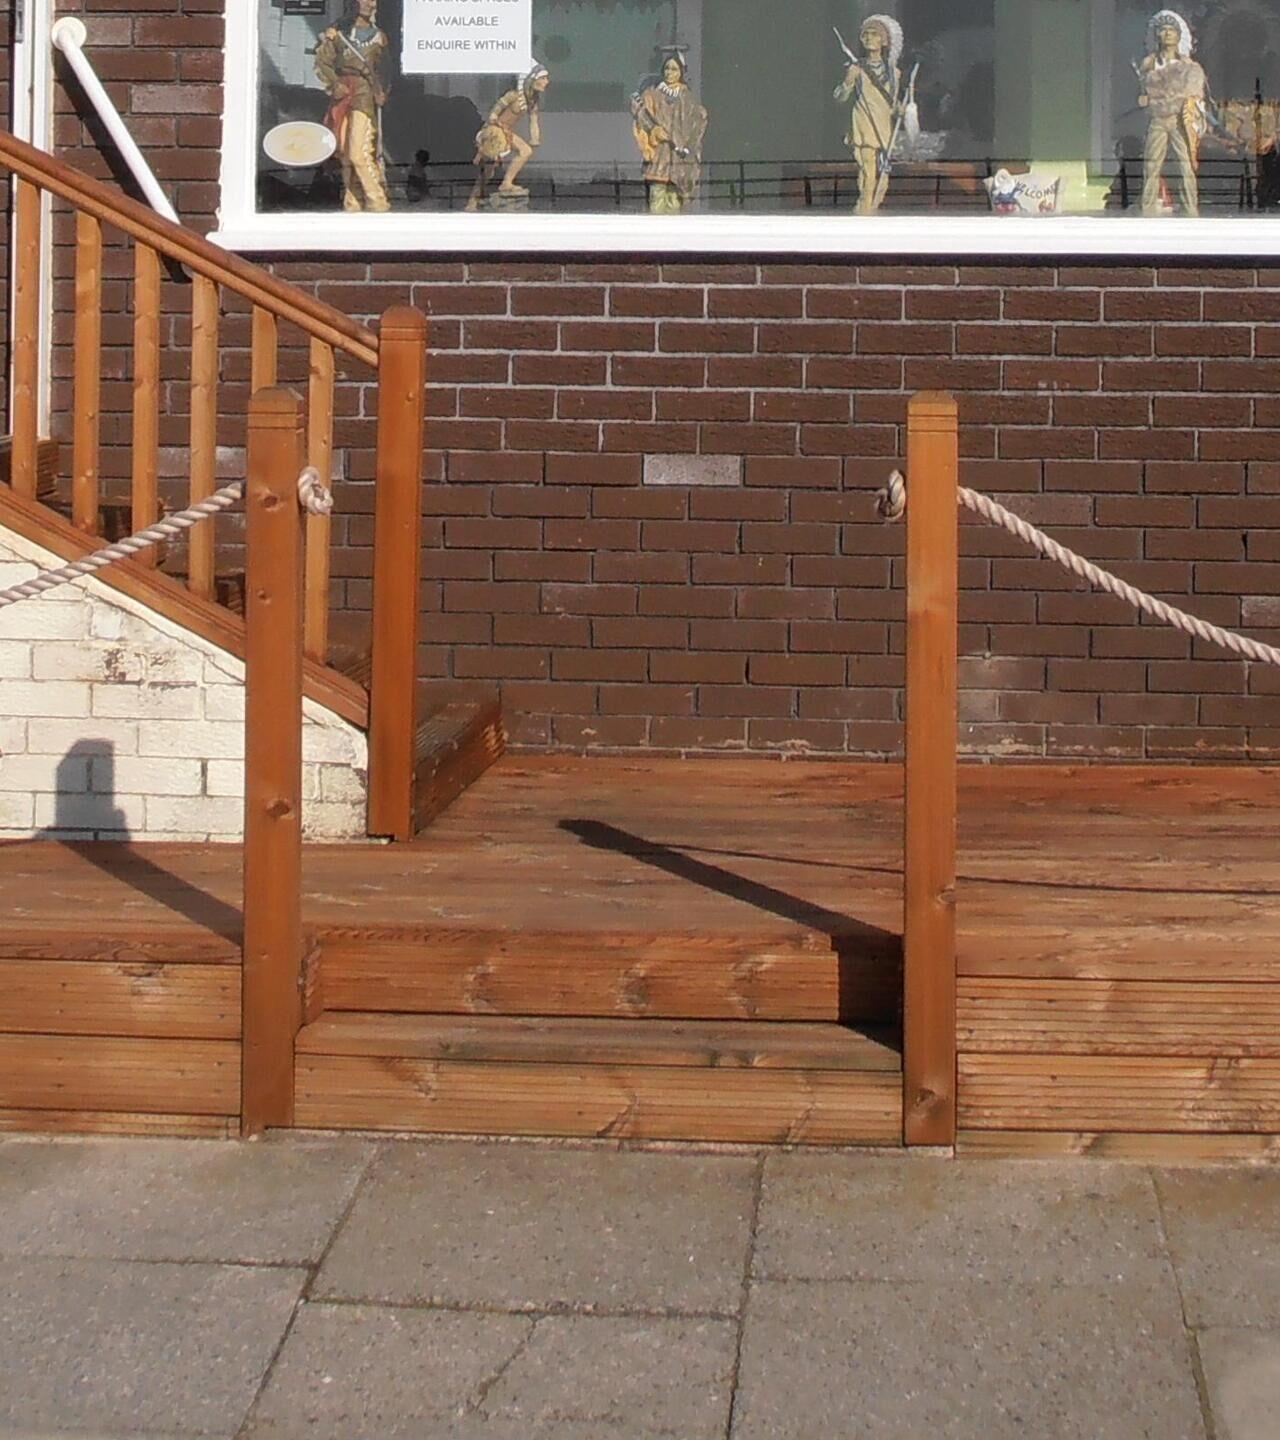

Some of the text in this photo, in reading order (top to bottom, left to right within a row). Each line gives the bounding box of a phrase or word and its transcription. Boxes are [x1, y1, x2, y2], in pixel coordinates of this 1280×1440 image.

[434, 16, 499, 27] AVAILABLE
[417, 40, 517, 51] ENQUIRE WITHIN
